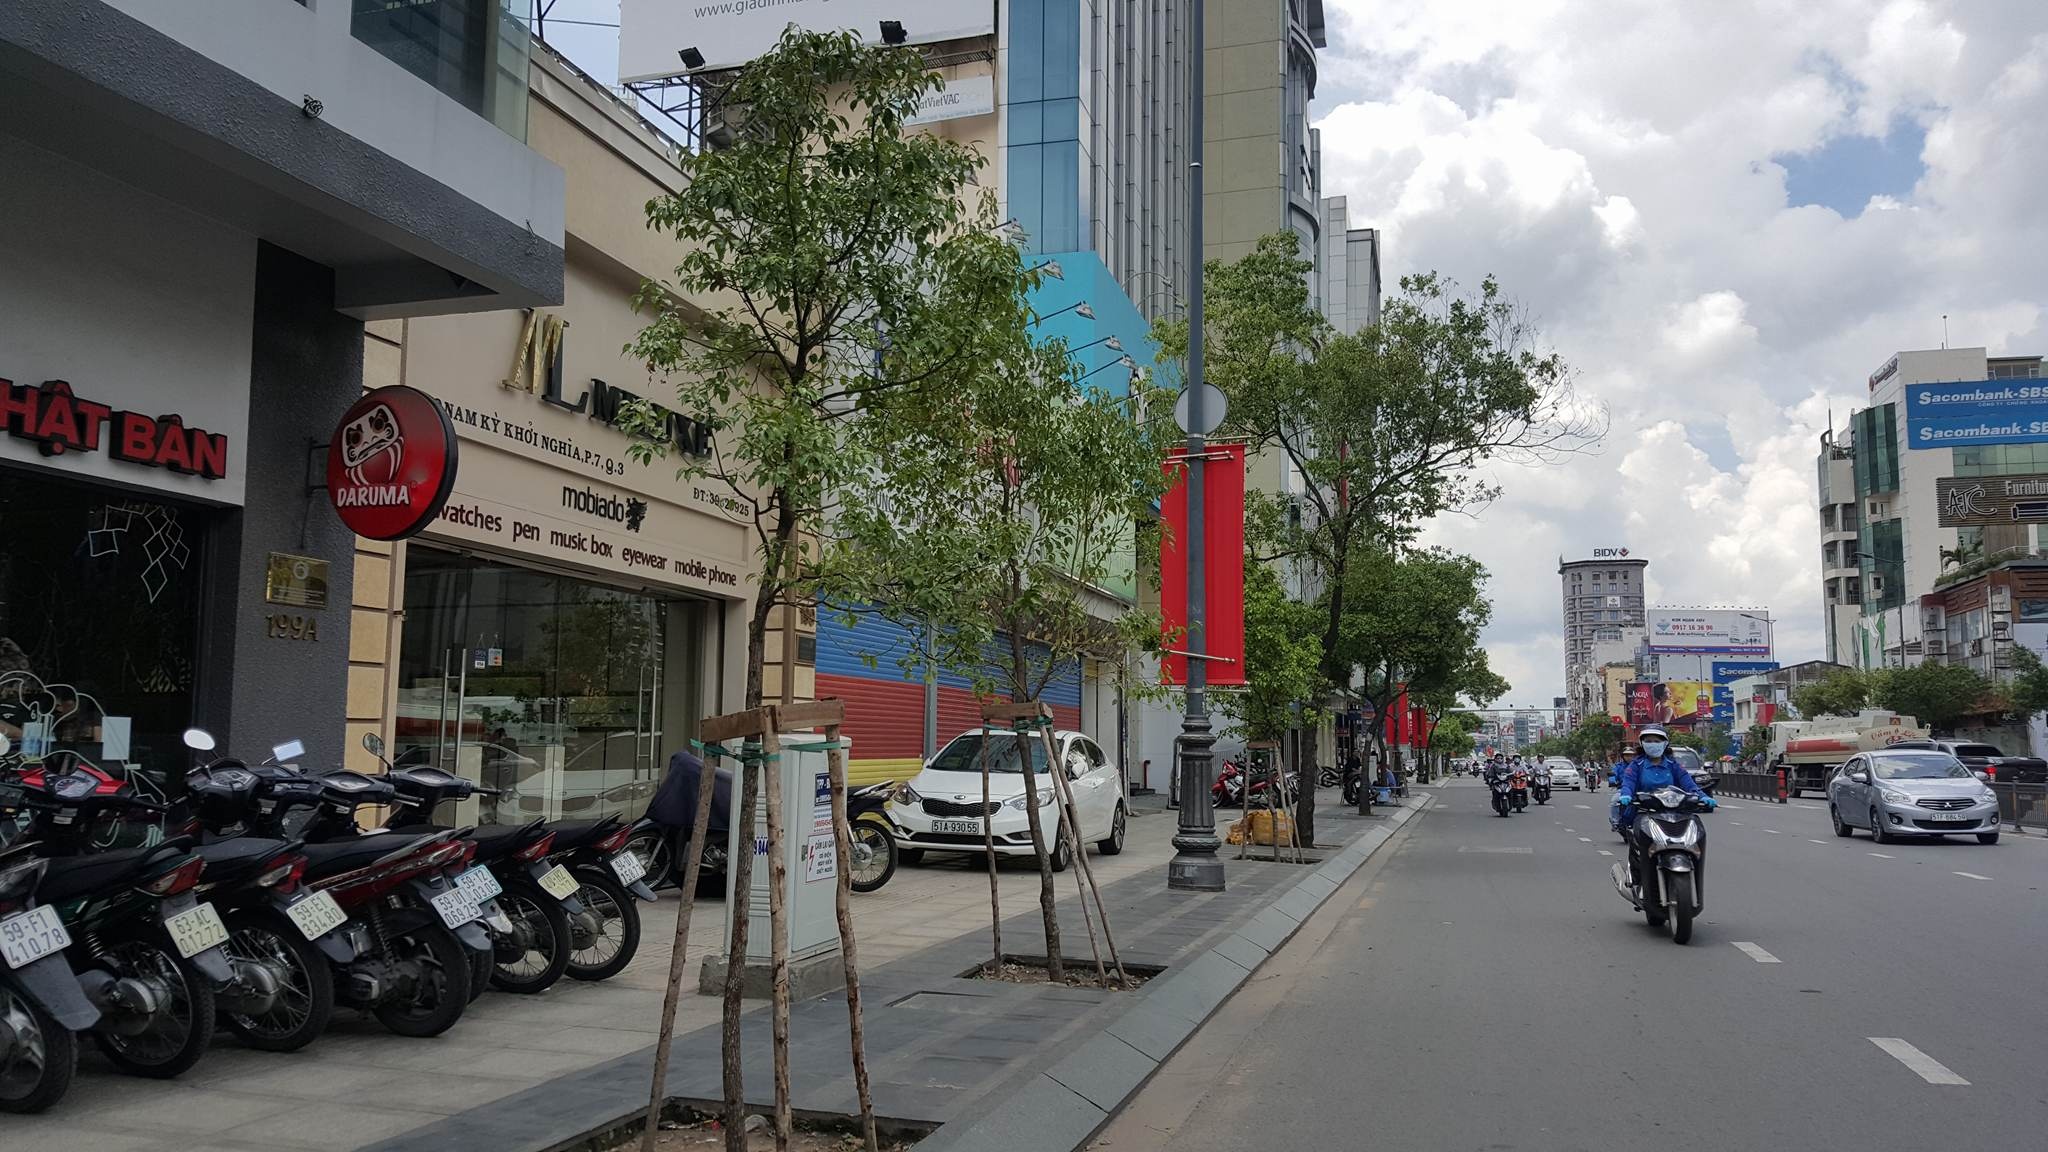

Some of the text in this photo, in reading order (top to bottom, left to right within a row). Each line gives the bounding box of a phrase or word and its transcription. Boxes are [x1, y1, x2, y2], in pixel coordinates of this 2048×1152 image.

[919, 93, 960, 109] atVietVAC
[445, 401, 477, 426] NAM
[480, 411, 501, 433] KỲ
[504, 421, 538, 446] KHỞI
[337, 485, 410, 507] DARUMA
[562, 485, 625, 522] mobiado
[513, 519, 540, 542] pen
[551, 527, 588, 552] music
[591, 538, 613, 558] box
[622, 546, 667, 570] eyewear
[675, 558, 707, 580] mobile
[708, 566, 737, 586] phone
[1593, 548, 1618, 557] BIDV
[265, 613, 319, 641] 199A
[3, 911, 49, 943] 59-F1
[174, 908, 212, 935] 63-AC
[8, 927, 65, 964] 410.78
[178, 922, 225, 954] 012.72
